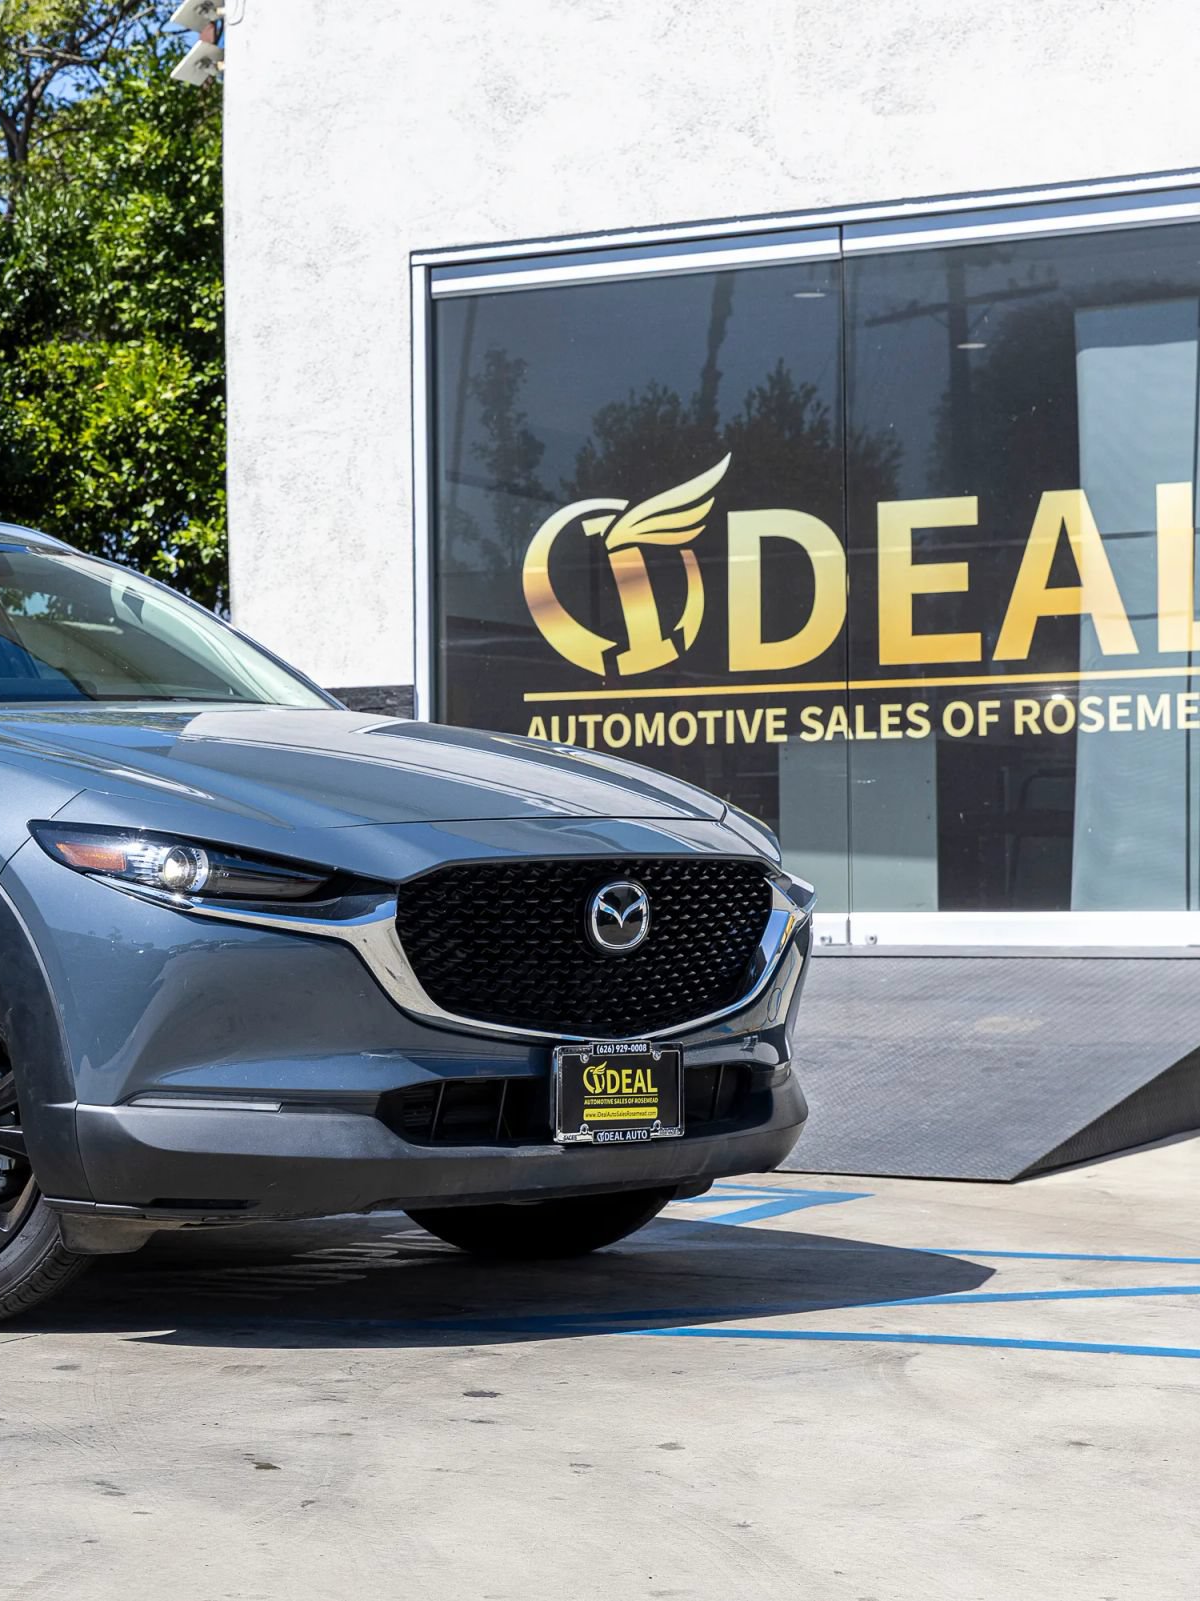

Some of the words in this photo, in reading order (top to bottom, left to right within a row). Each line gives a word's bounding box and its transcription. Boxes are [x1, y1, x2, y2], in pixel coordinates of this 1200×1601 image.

[527, 708, 788, 748] AUTOMOTIVE
[800, 700, 932, 742] SALES
[942, 700, 1000, 738] OF
[1013, 692, 1200, 736] ROSEME
[596, 1045, 615, 1055] (626)
[615, 1043, 647, 1053] 929-0008
[614, 1097, 628, 1105] SALES
[626, 1130, 648, 1140] AUTO
